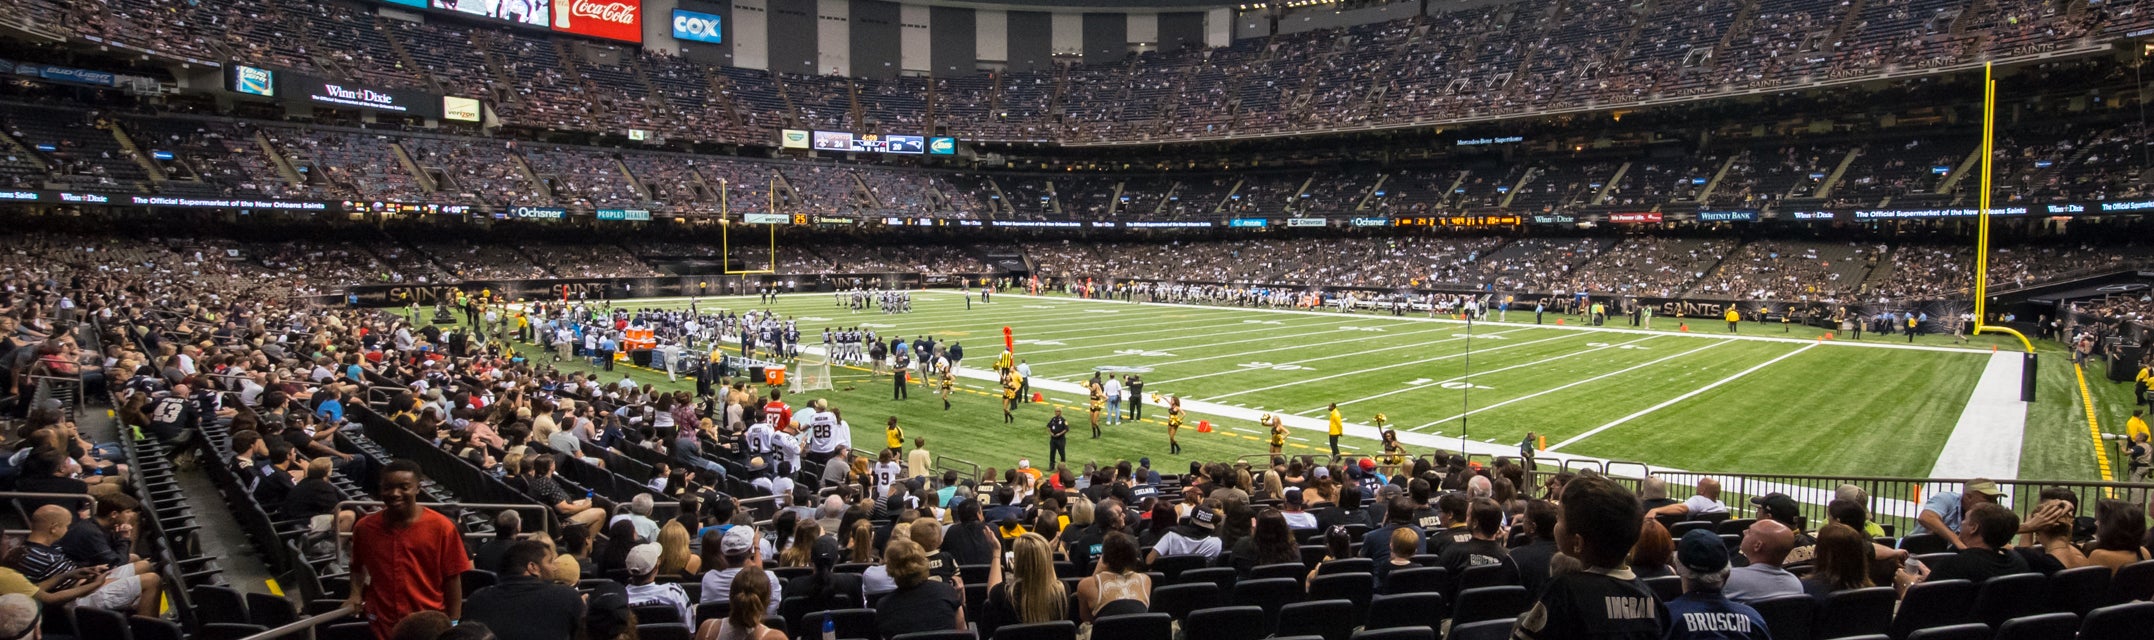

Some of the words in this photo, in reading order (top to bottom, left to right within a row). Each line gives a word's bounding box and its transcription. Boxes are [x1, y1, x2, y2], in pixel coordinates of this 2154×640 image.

[674, 15, 720, 39] COX
[2013, 42, 2055, 57] SAINTS
[1918, 56, 1957, 69] SAINTS
[325, 84, 356, 98] Winn
[364, 89, 392, 104] Dixie
[448, 110, 475, 118] verizon
[834, 140, 844, 148] 24
[892, 143, 902, 151] 20
[14, 191, 38, 200] Saints
[61, 192, 81, 202] Winn
[87, 194, 108, 203] Dixie
[132, 196, 148, 204] The
[150, 197, 178, 205] Official
[179, 198, 230, 208] Supermarket
[240, 200, 254, 208] the
[273, 201, 302, 209] Orleans
[302, 202, 325, 210] Saints
[2102, 203, 2112, 211] The
[2112, 202, 2130, 210] Official
[518, 207, 562, 218] Ochsner
[1896, 209, 1940, 218] Supermarket
[1963, 208, 1979, 216] New
[2047, 205, 2064, 213] Winn
[2068, 204, 2084, 213] Dixie
[598, 210, 624, 219] PEOPLES
[795, 214, 806, 224] 25
[1534, 215, 1552, 223] Winn
[1556, 215, 1575, 223] Dixie
[1701, 212, 1731, 220] WHITNEY
[1731, 211, 1750, 220] BANK
[1794, 211, 1811, 219] Winn
[1816, 211, 1834, 219] Dixie
[1355, 217, 1386, 226] Ochsner
[1663, 302, 1721, 317] SAINTS
[768, 371, 776, 379] G
[766, 413, 781, 428] 87
[813, 424, 832, 439] 28
[752, 437, 761, 453] 9
[881, 472, 889, 485] 9
[1419, 515, 1441, 527] BREES
[1683, 612, 1751, 633] BRUSCHI
